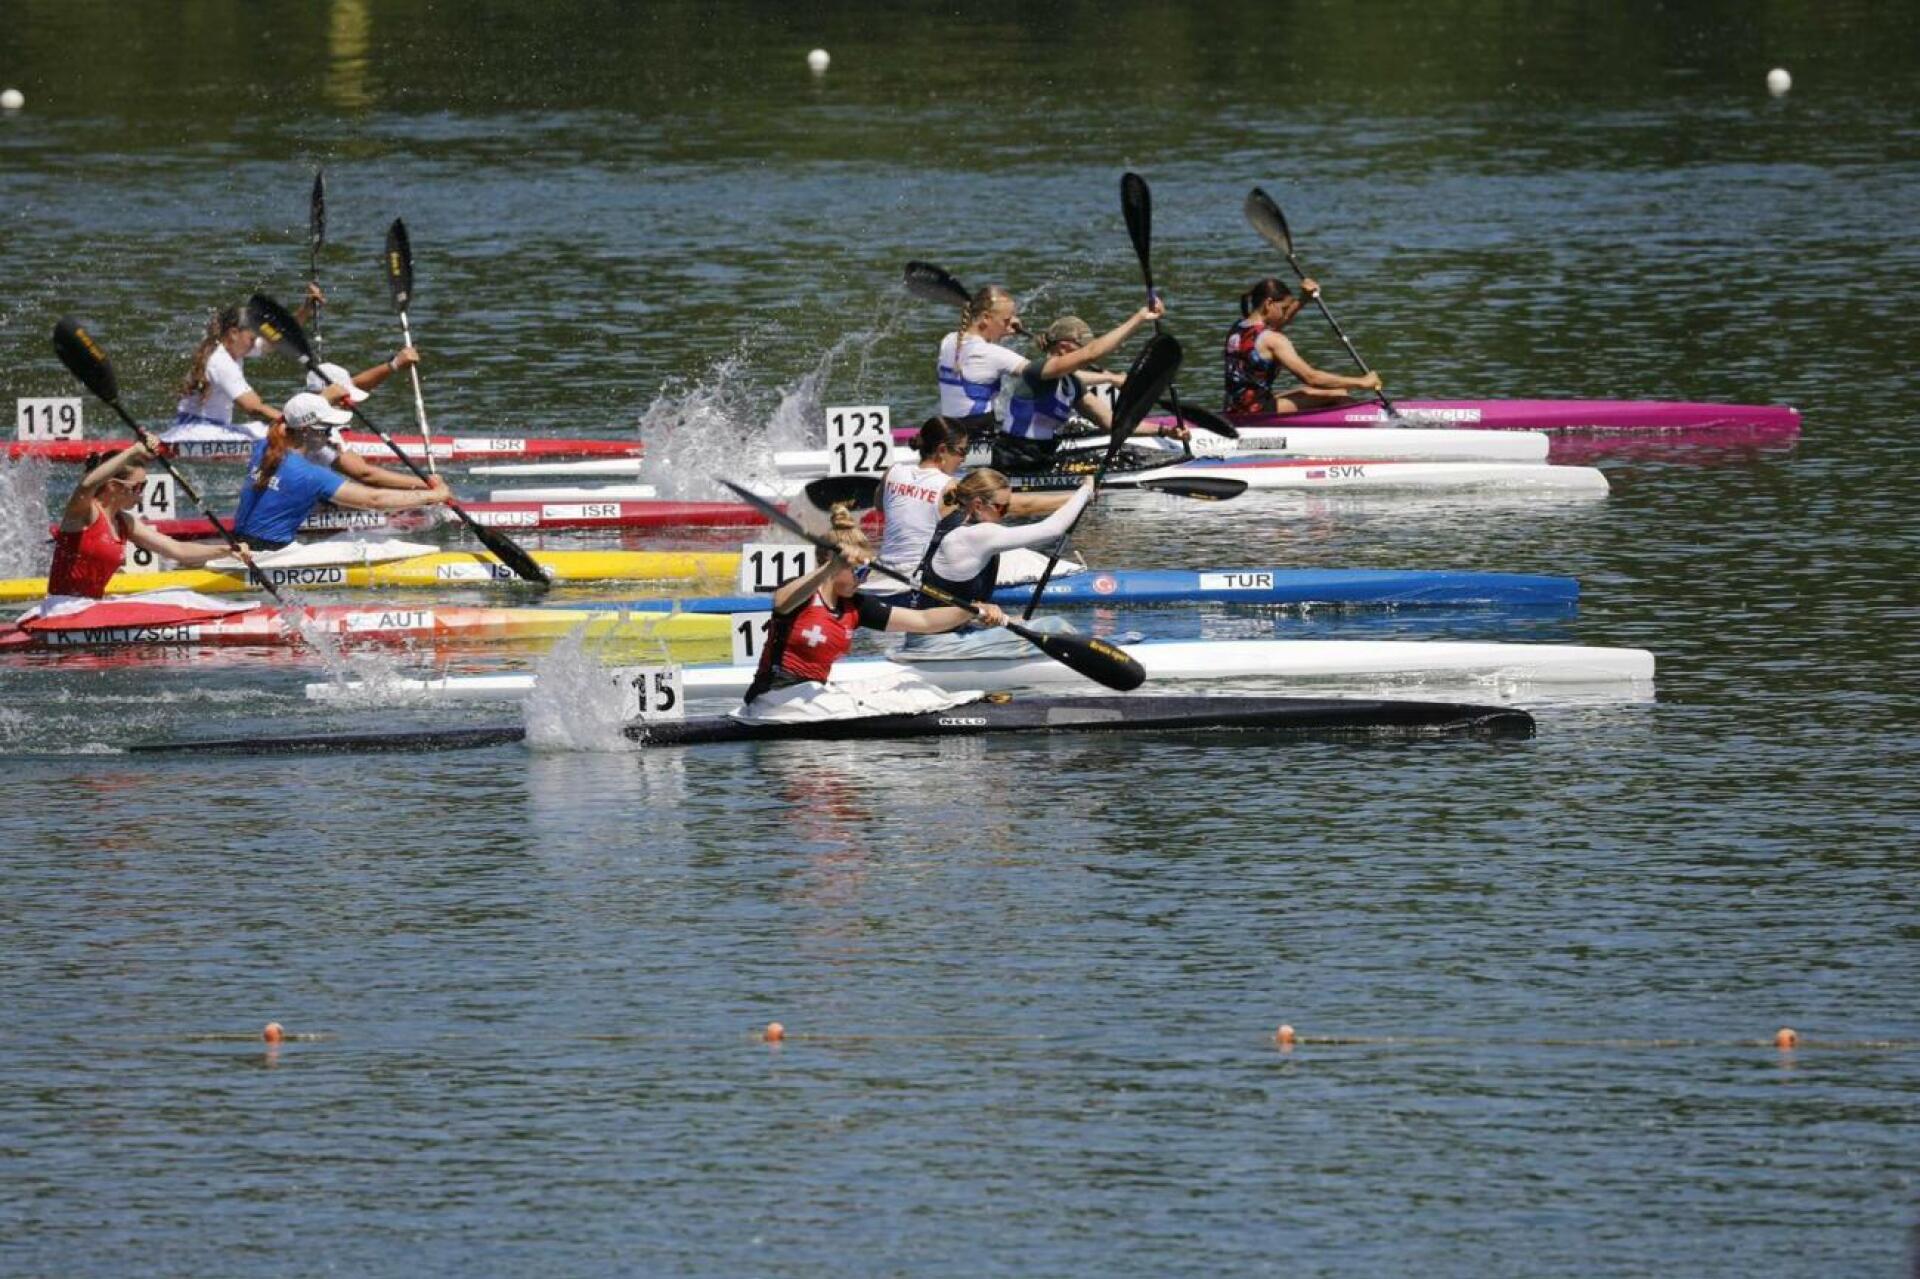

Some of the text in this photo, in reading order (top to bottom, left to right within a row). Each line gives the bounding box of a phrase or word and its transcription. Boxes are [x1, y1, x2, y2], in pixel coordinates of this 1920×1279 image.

[23, 404, 77, 434] 119
[832, 412, 884, 436] 123
[489, 439, 521, 450] ISR
[834, 441, 889, 473] 122
[1328, 466, 1365, 478] SVK
[582, 504, 617, 517] ISR
[273, 567, 342, 585] DROZD
[750, 550, 806, 586] 111
[1222, 573, 1271, 587] TUR
[379, 611, 427, 628] AUT
